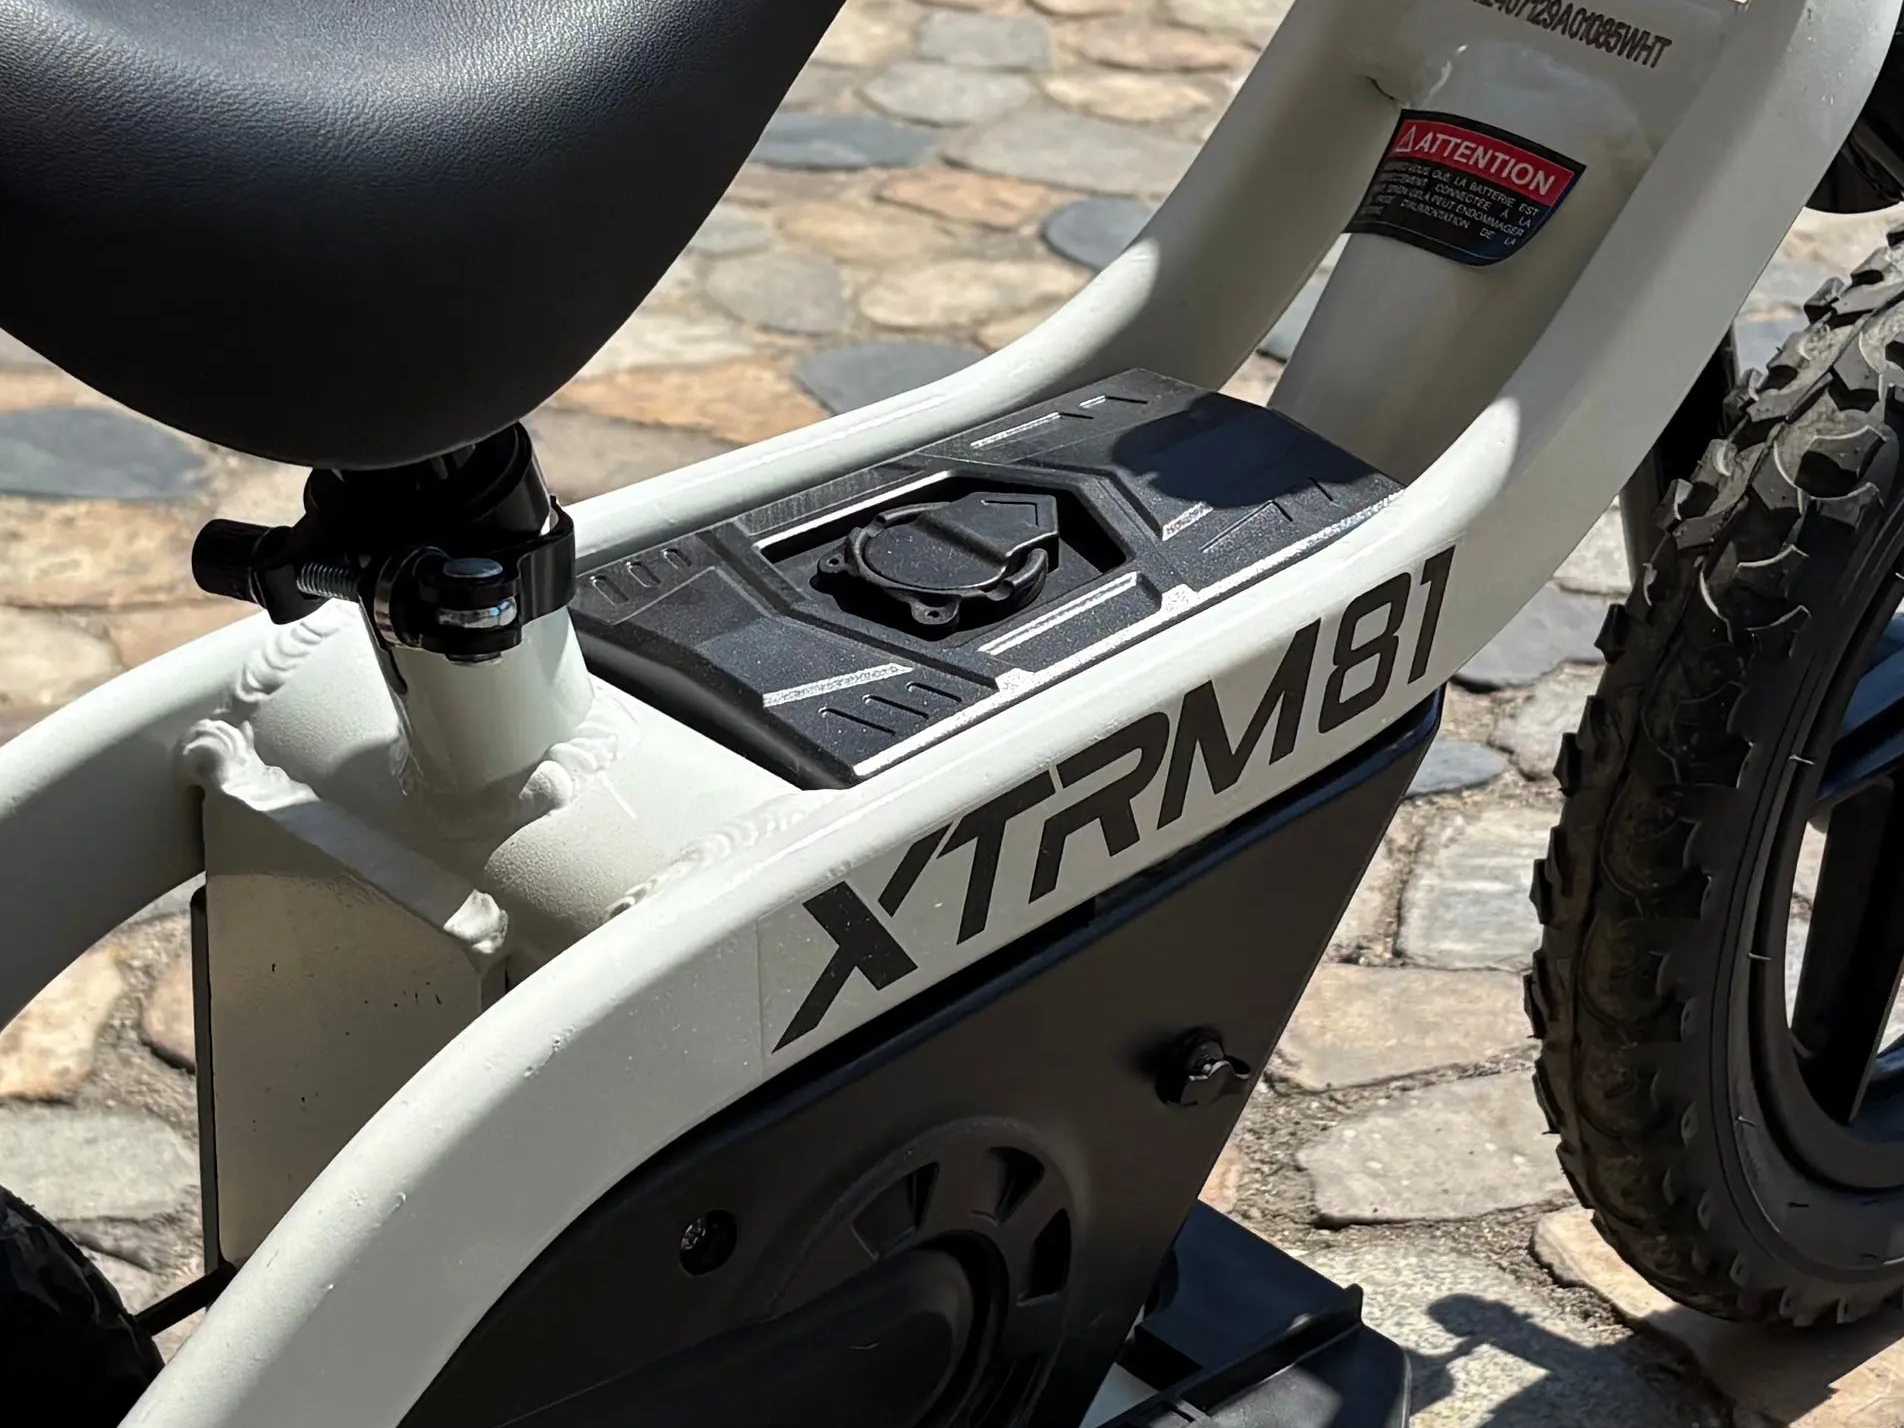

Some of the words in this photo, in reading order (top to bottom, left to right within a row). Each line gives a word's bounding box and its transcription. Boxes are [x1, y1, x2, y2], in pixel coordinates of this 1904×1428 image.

[1415, 132, 1555, 196] ATTENTION
[1454, 175, 1467, 187] LA
[1470, 181, 1516, 208] BATTERIE
[1518, 203, 1540, 216] EST
[1456, 204, 1525, 238] ENDOMMAGER
[1479, 227, 1495, 240] DE
[1504, 236, 1517, 247] LA
[1518, 216, 1532, 228] LA
[774, 545, 1455, 1053] XTRM81
